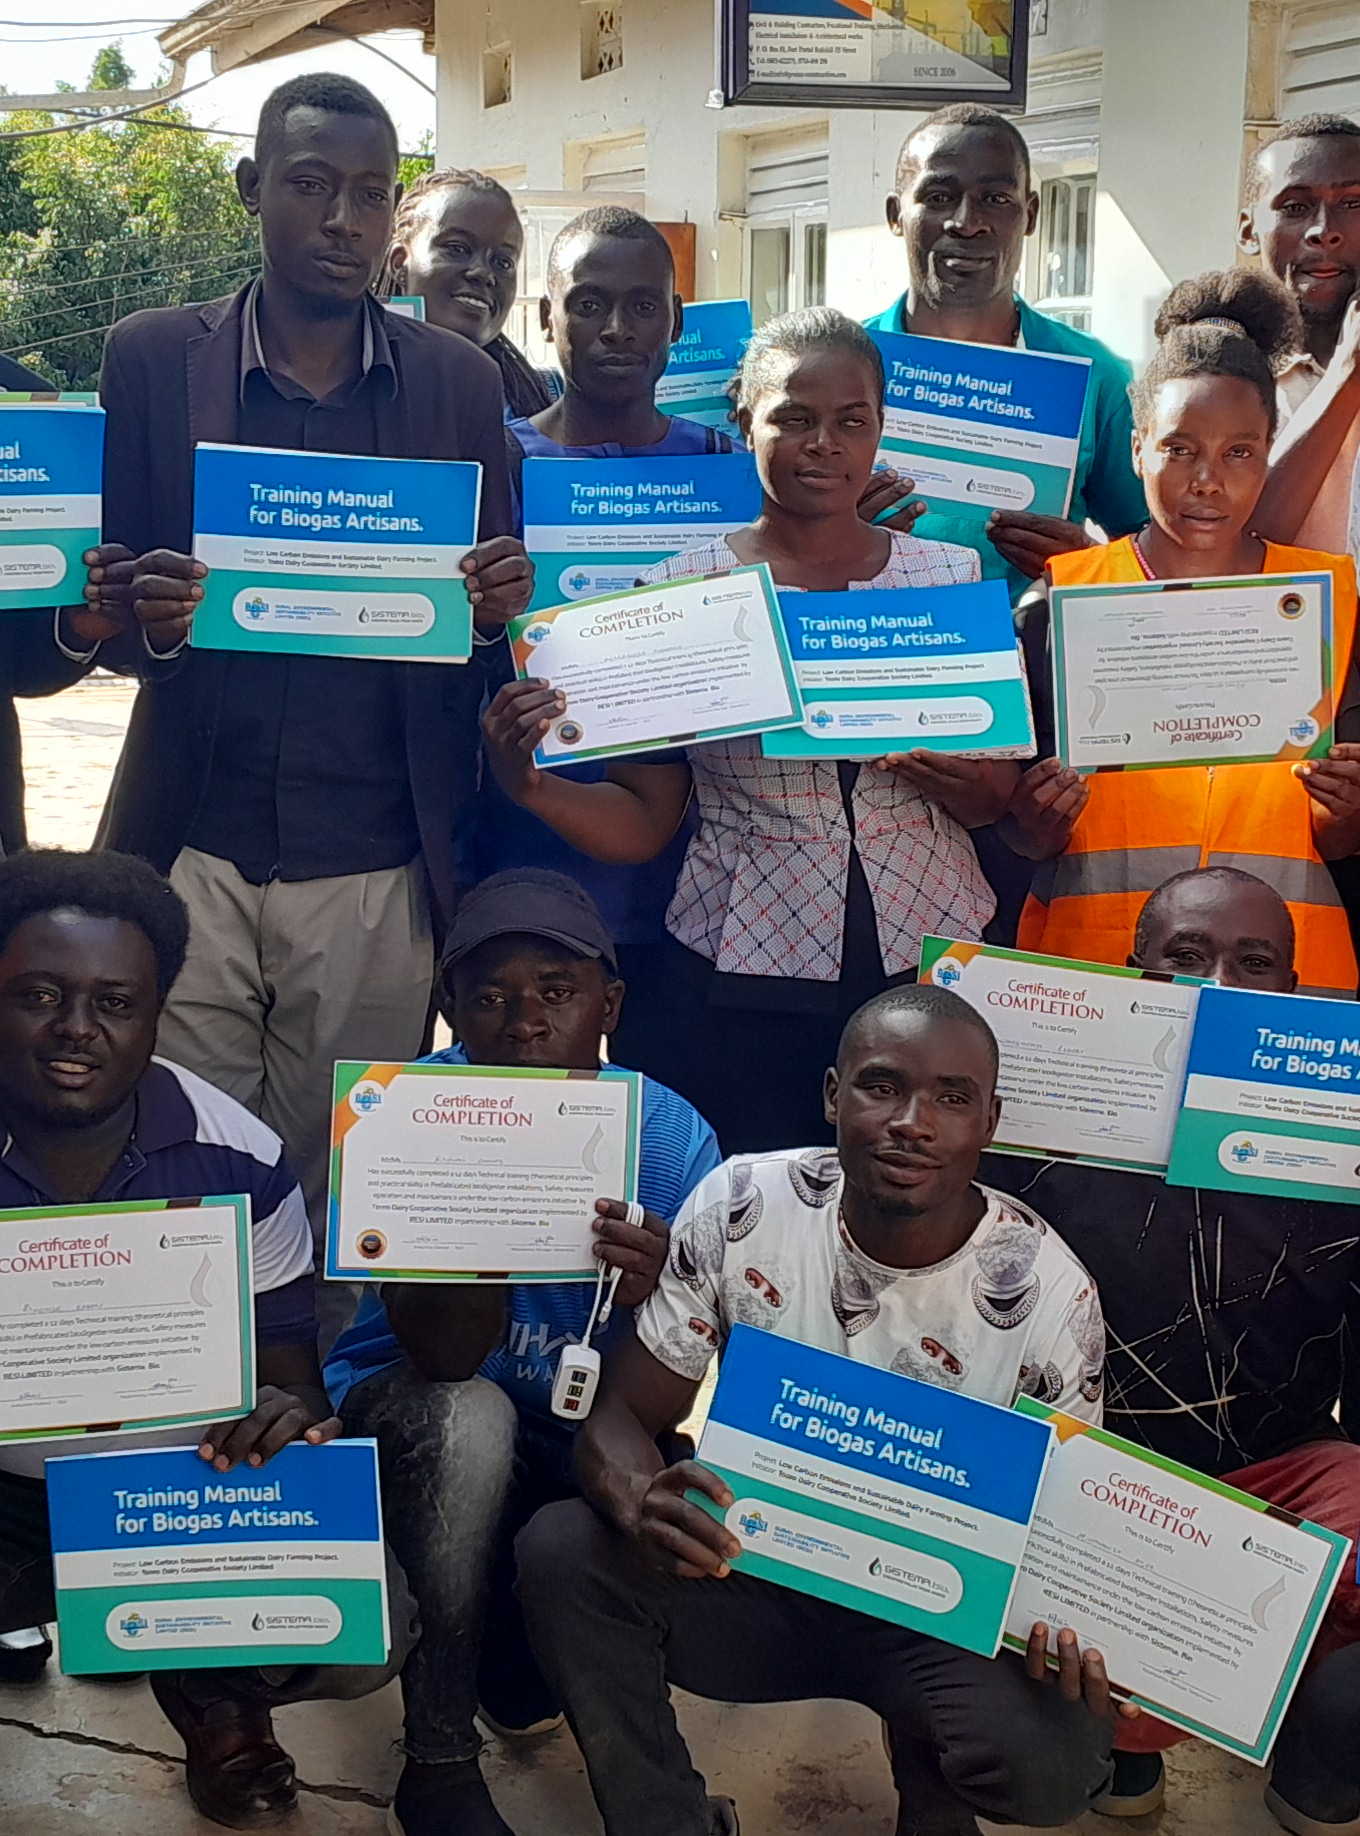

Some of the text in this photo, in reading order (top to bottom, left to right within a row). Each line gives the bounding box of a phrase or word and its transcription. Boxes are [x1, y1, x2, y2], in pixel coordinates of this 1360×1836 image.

[669, 345, 726, 365] Artisans.
[892, 361, 1012, 395] Training Manual
[886, 378, 1034, 419] for Biogas Artisans.
[249, 483, 393, 509] Training Manual
[570, 482, 694, 499] Training Manual
[249, 505, 423, 531] for Biogas Artisans.
[571, 499, 720, 517] for Biogas Artisans.
[578, 608, 683, 638] COMPLETION
[594, 600, 663, 624] Certificate of
[798, 613, 933, 633] Training Manual
[801, 632, 965, 651] for Biogas Artisans.
[1152, 713, 1261, 733] COMPLETION
[1169, 729, 1242, 745] Certificate of
[1007, 978, 1087, 1001] Certificate of
[986, 990, 1104, 1020] COMPLETION
[1256, 1027, 1335, 1057] Training
[1251, 1049, 1283, 1070] for
[1285, 1054, 1352, 1080] Biogas
[432, 1093, 514, 1109] Certificate of
[411, 1108, 532, 1127] COMPLETION
[18, 1233, 109, 1253] Certificate of
[780, 1378, 942, 1448] Training Manual
[771, 1403, 970, 1487] for Biogas Artisans.
[113, 1481, 281, 1509] Training Manual
[1108, 1472, 1199, 1520] Certificate of
[115, 1507, 319, 1534] for Biogas Artisans.
[1080, 1478, 1213, 1548] COMPLETION
